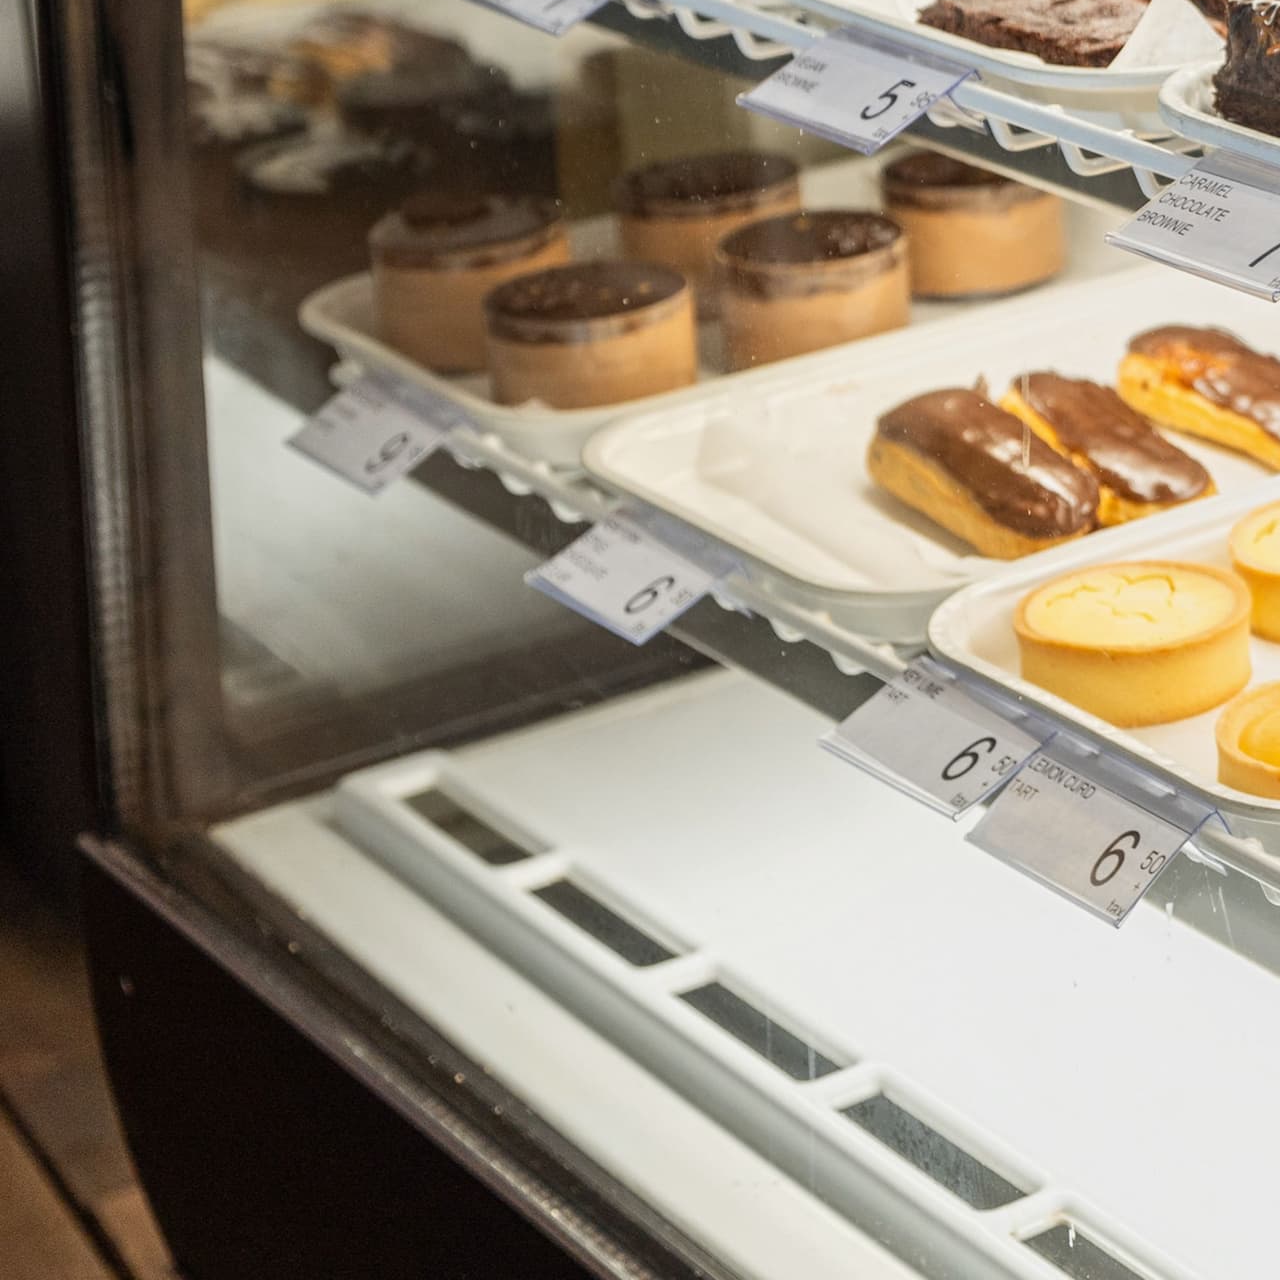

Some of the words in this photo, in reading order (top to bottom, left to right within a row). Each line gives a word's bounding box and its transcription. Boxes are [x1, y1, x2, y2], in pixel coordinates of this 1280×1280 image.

[861, 80, 916, 119] 5
[1179, 173, 1234, 199] CARAMEL
[1136, 210, 1195, 237] BROWNIE
[1158, 192, 1230, 223] CHOCOLATE
[624, 575, 674, 613] 6
[941, 737, 996, 780] 6
[993, 756, 1017, 775] 50
[1008, 779, 1039, 801] TART
[1027, 756, 1065, 783] LEMON
[1064, 775, 1096, 799] CURD
[1090, 831, 1140, 886] 6
[1141, 851, 1165, 874] 50
[1104, 898, 1124, 917] tax
